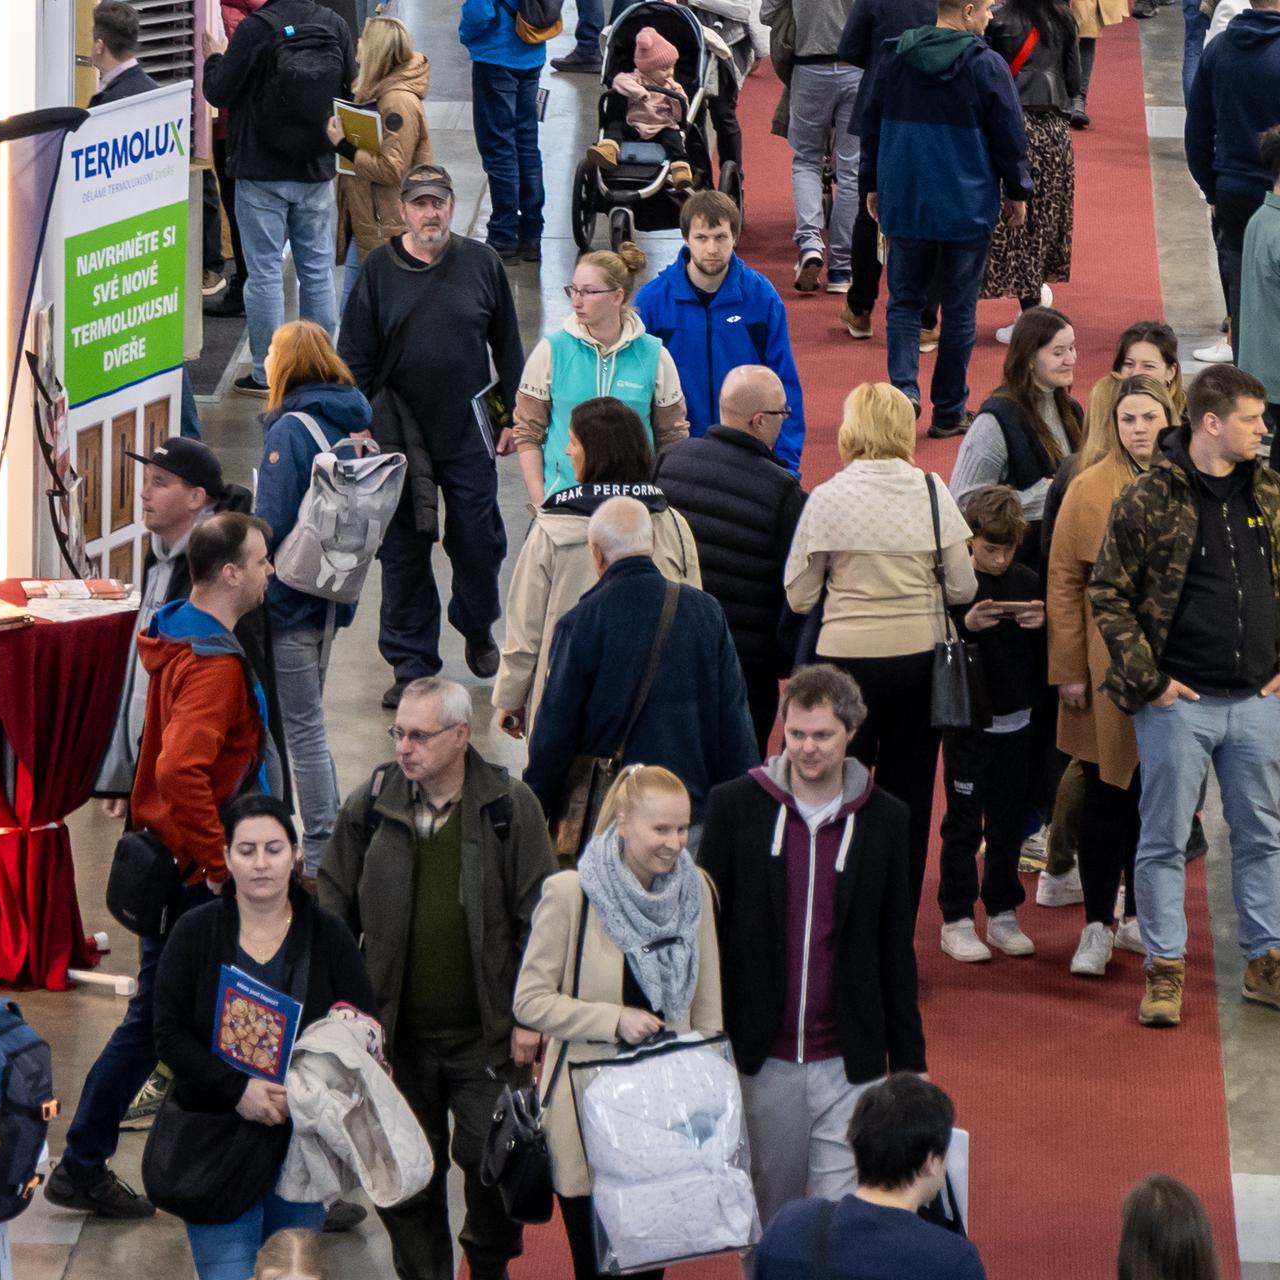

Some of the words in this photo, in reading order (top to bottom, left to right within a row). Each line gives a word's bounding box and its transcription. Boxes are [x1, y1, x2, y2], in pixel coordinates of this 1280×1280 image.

[71, 118, 185, 183] TERMOLUX
[82, 186, 108, 204] DĚLÁME
[75, 230, 160, 278] NAVRHNĚTE
[162, 225, 177, 248] SI
[92, 273, 120, 308] SVÉ
[121, 263, 159, 294] NOVÉ
[71, 286, 179, 349] TERMOLUXUSNÍ
[102, 335, 147, 372] DVEŘE
[555, 486, 584, 505] PEAK
